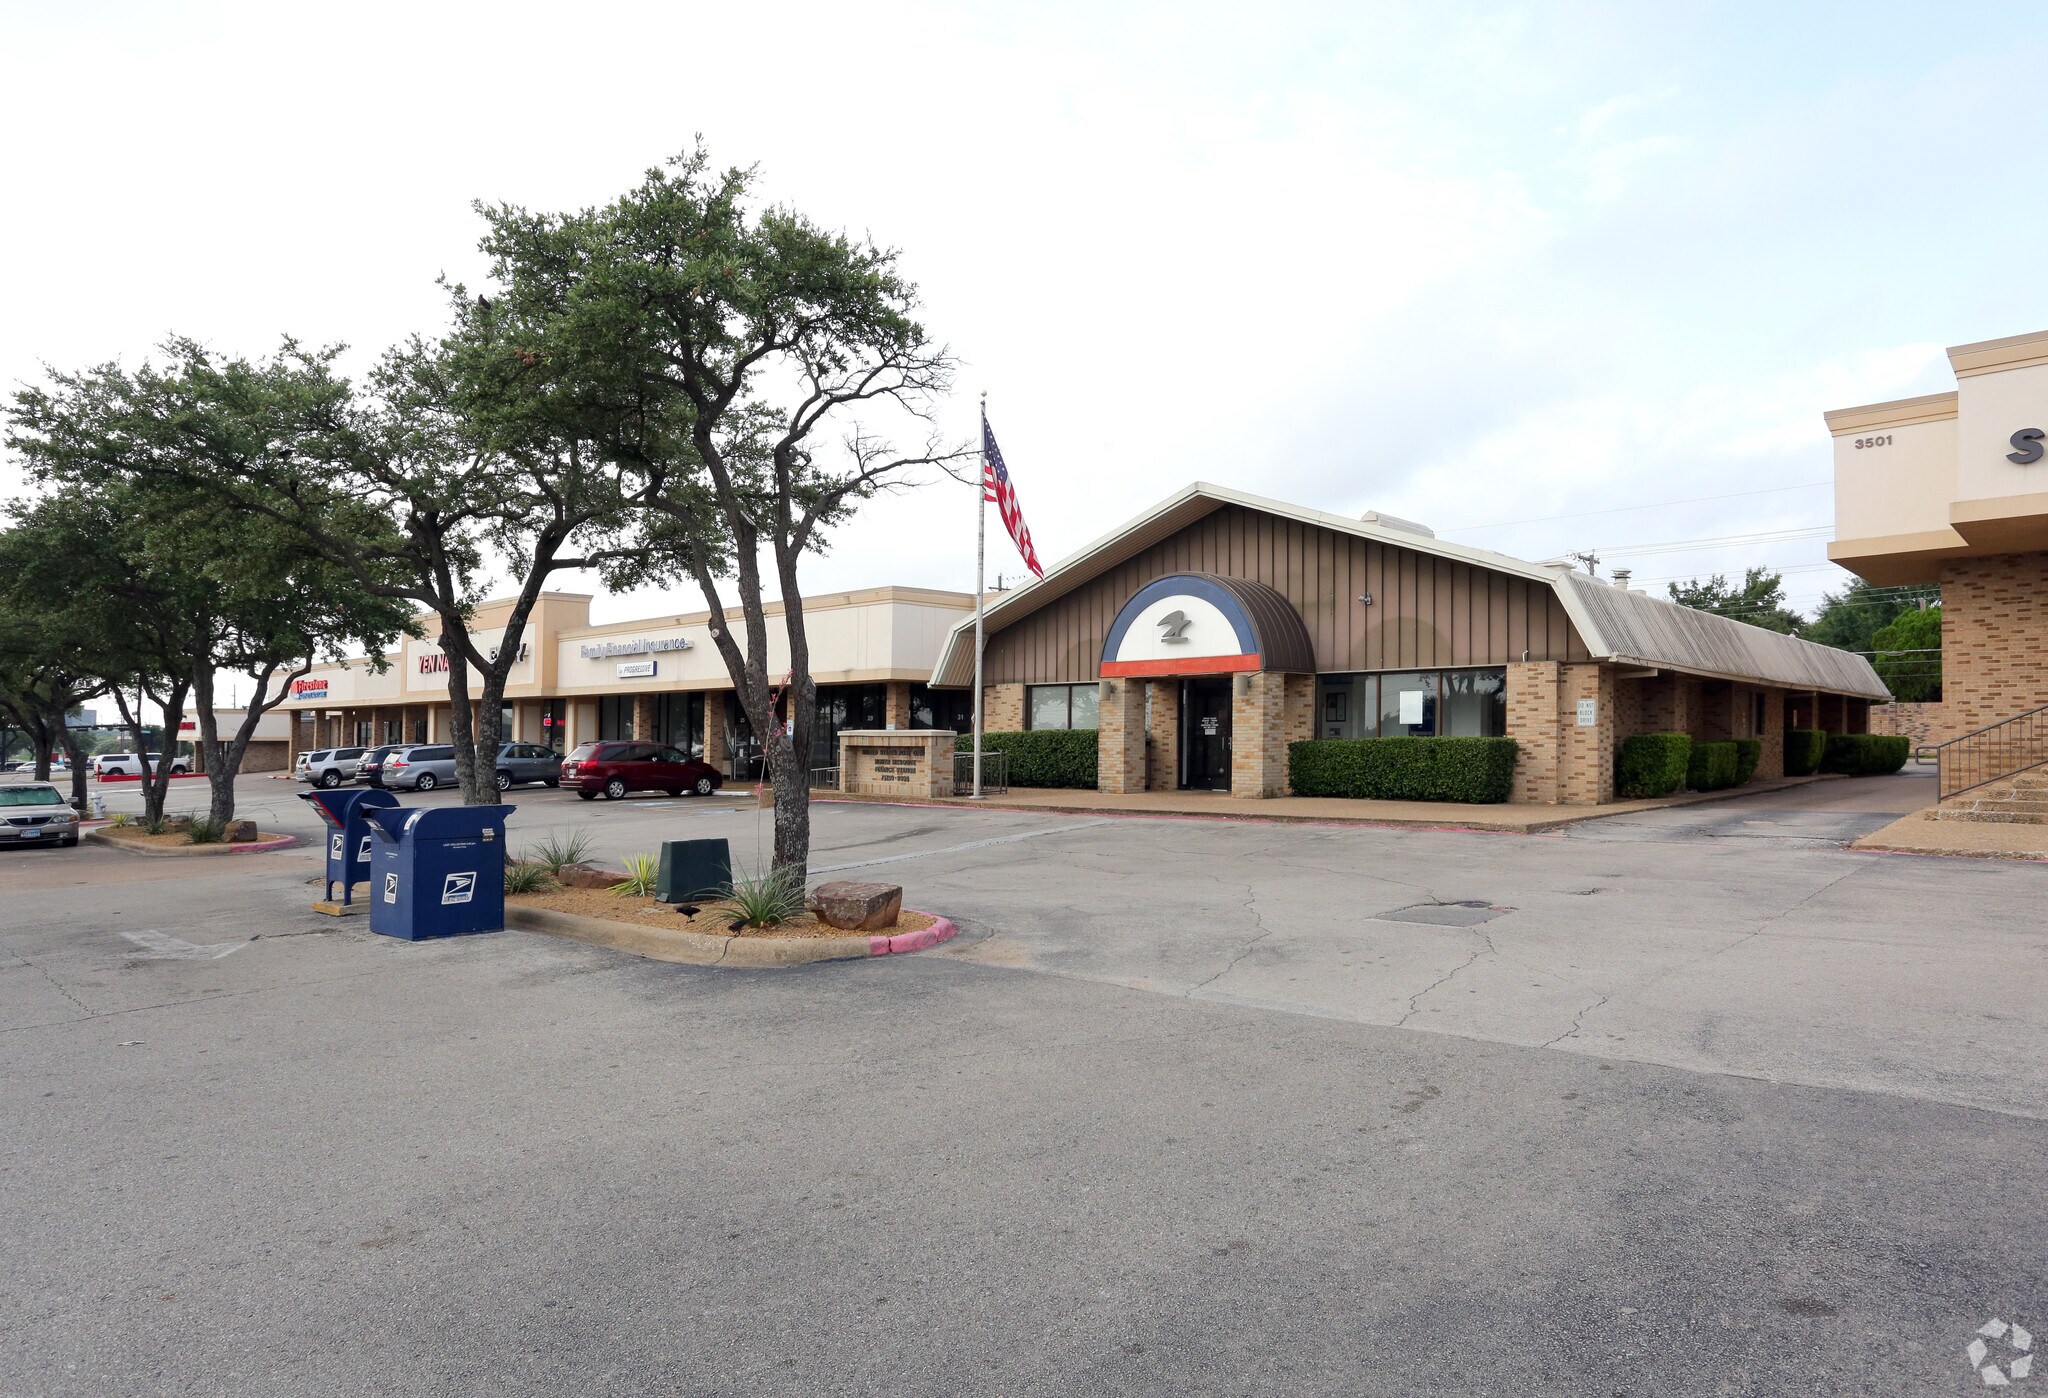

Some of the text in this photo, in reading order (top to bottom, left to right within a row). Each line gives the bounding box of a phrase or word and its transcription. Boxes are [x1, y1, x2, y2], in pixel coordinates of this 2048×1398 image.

[1854, 434, 1893, 450] 3501
[581, 637, 686, 660] Family Financial Insurance
[297, 680, 328, 693] Firestone
